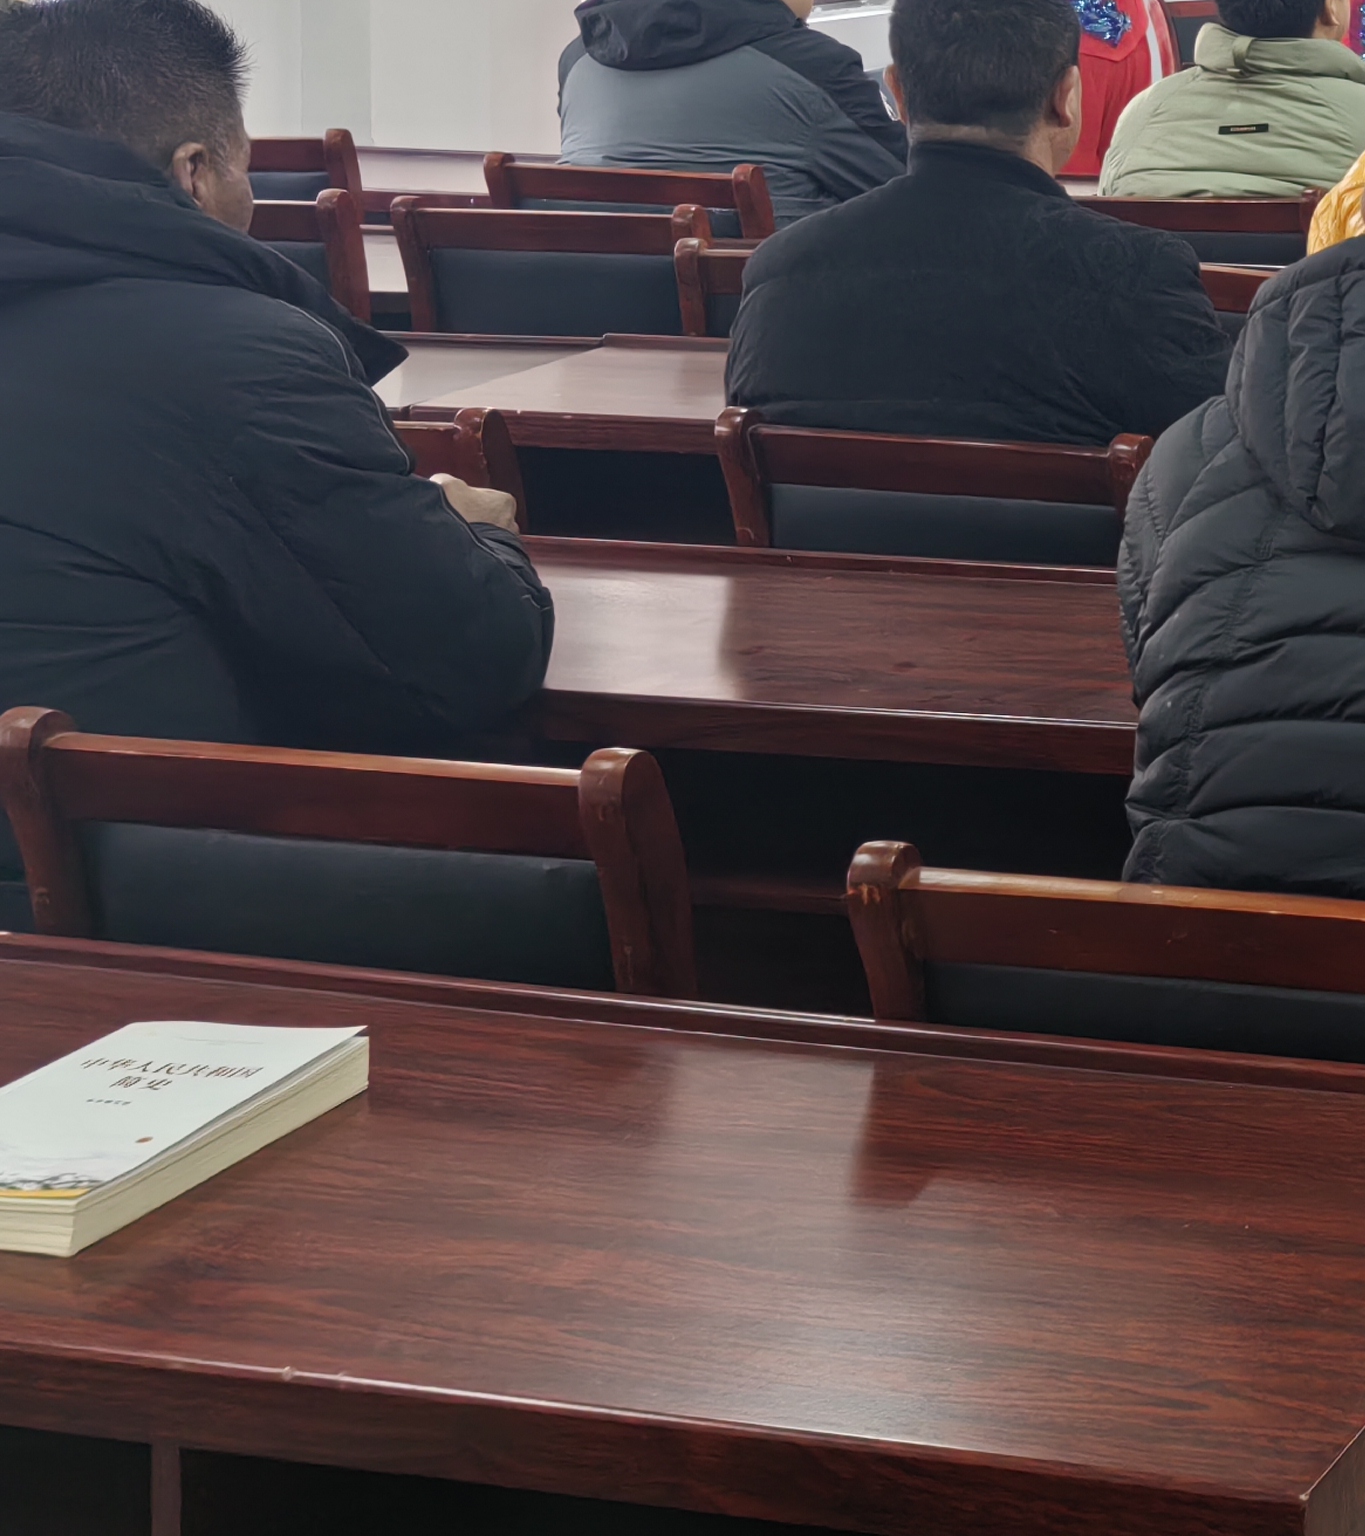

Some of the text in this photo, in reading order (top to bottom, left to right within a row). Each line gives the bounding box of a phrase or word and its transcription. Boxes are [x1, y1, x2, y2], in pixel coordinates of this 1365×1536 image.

[80, 1056, 265, 1079] 中华人民共和国
[109, 1075, 173, 1091] 简史
